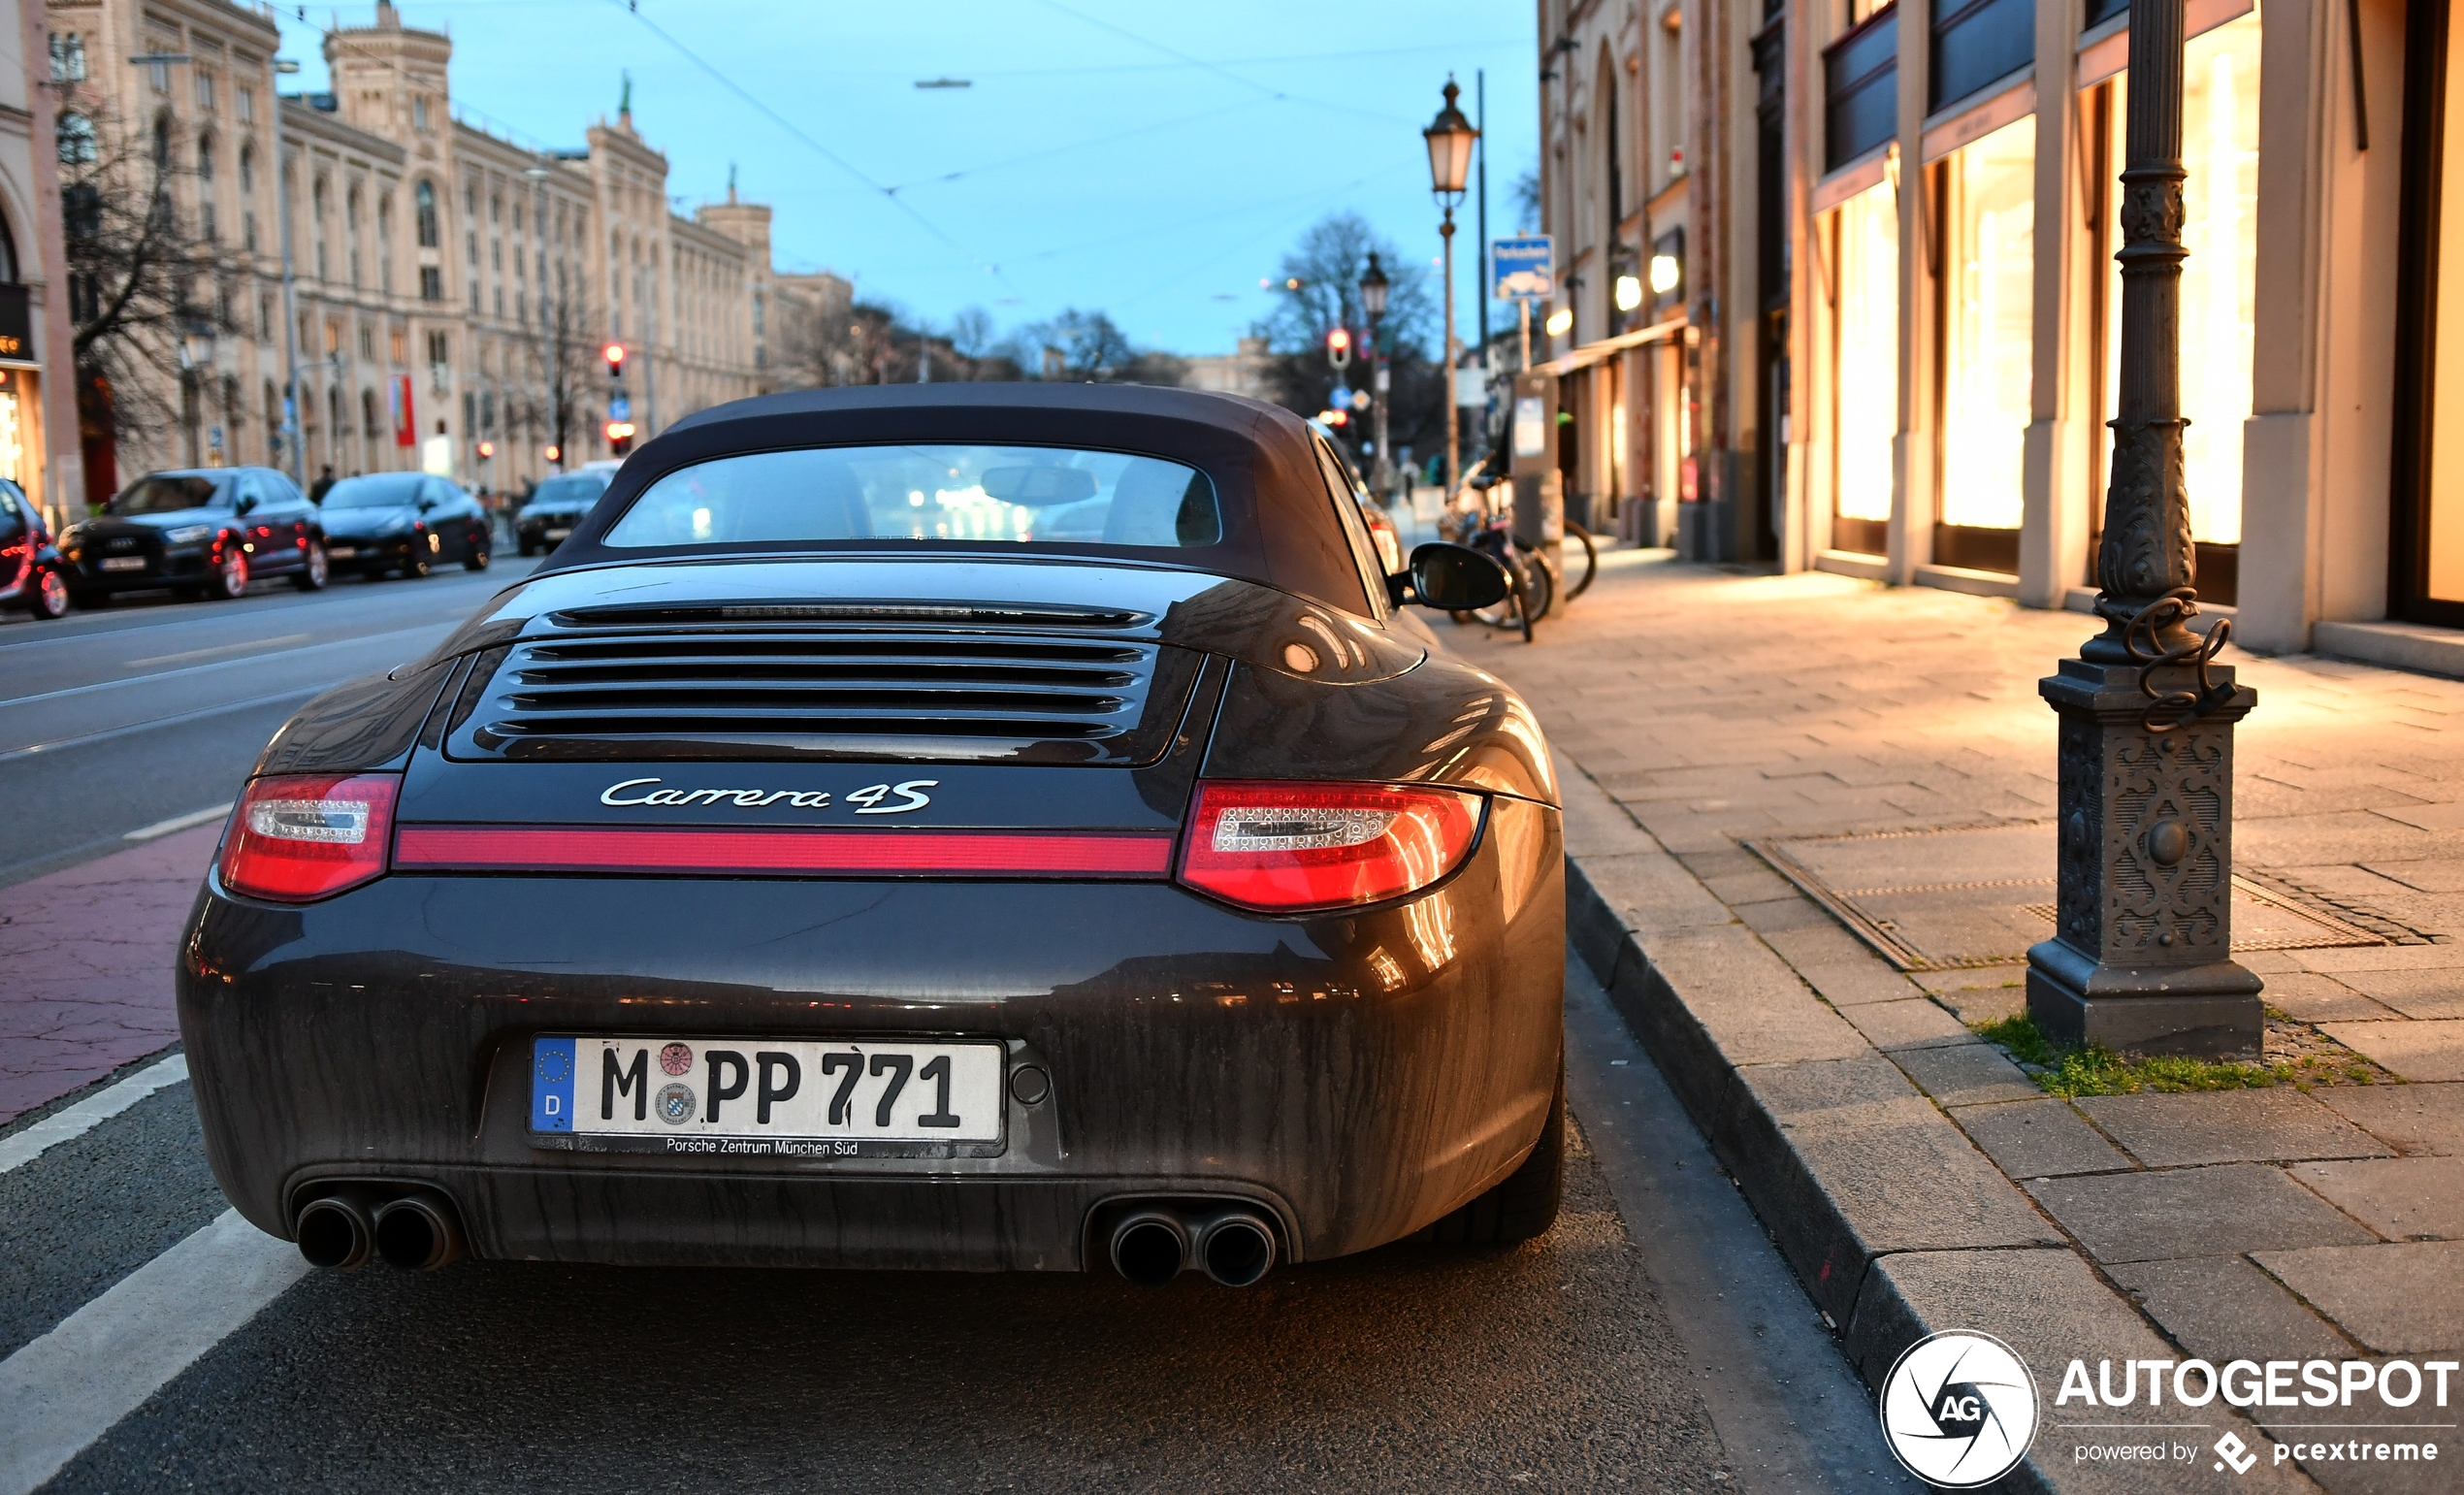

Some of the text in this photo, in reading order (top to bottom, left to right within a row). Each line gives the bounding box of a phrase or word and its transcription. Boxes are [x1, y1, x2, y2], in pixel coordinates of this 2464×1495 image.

[600, 777, 939, 814] Carrera 4S
[601, 1048, 649, 1121] M
[705, 1050, 801, 1123] PP
[822, 1053, 960, 1127] 771
[545, 1094, 562, 1116] D
[666, 1138, 859, 1155] Porsche Zentrum München Süd
